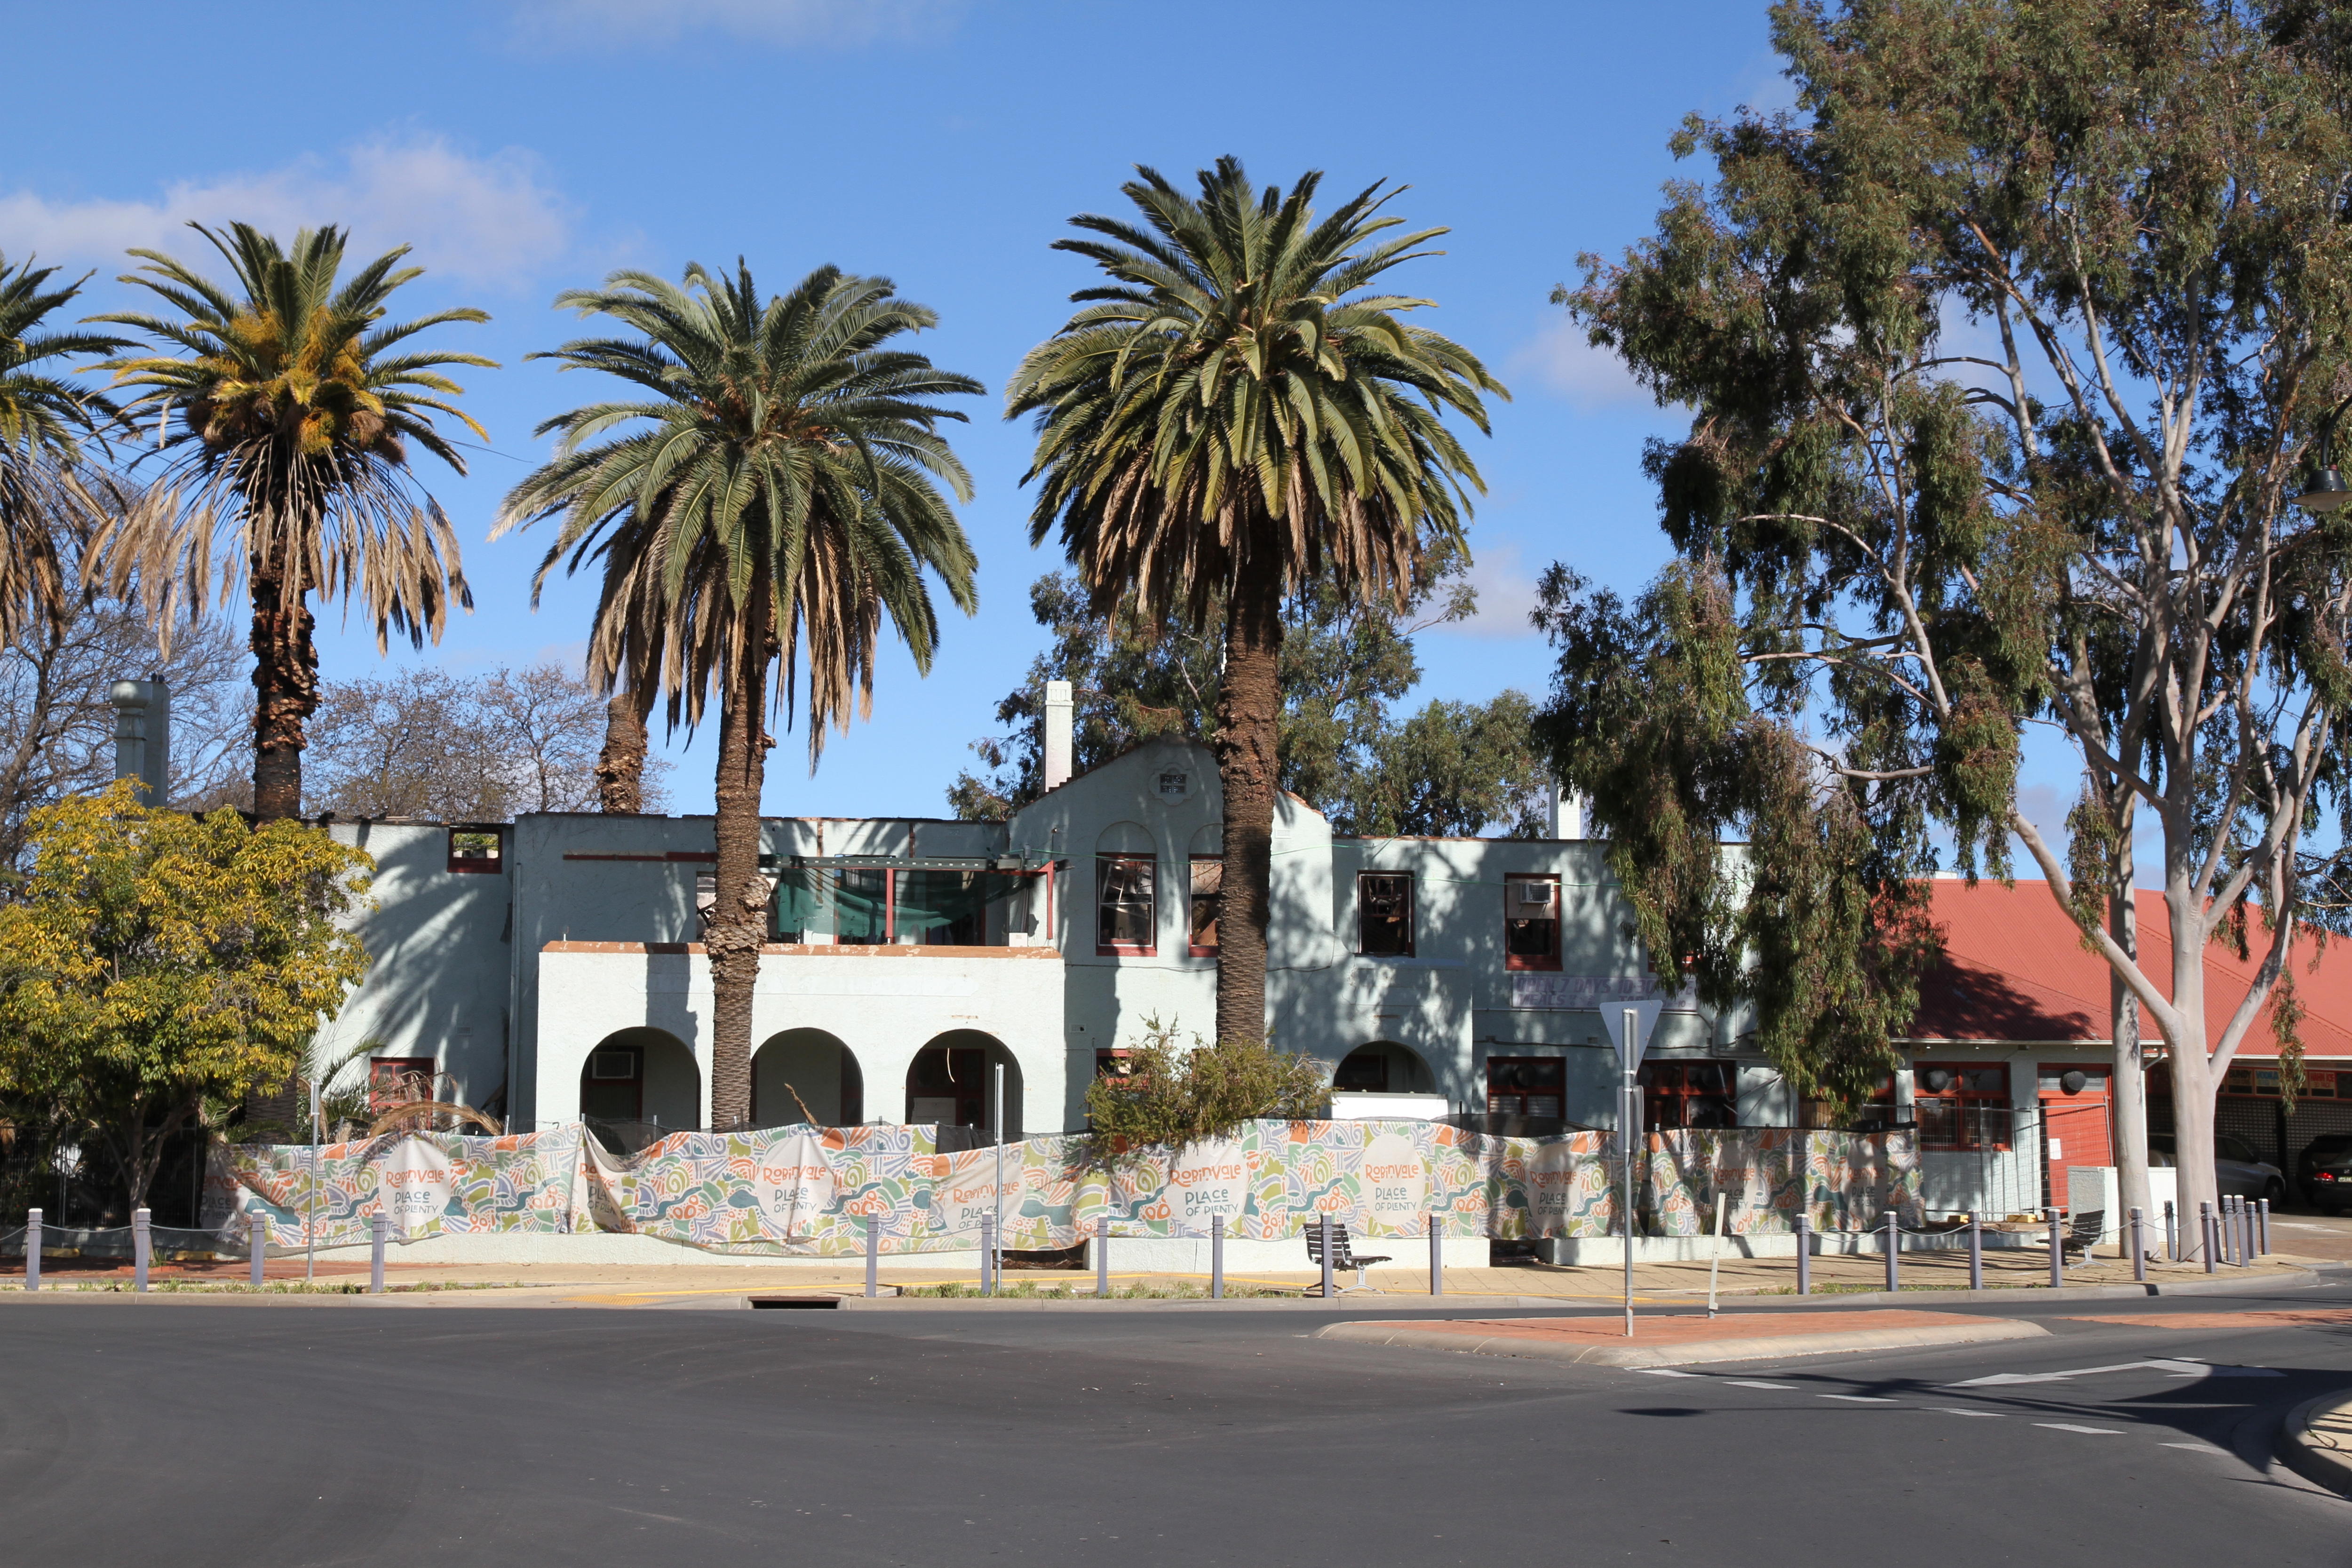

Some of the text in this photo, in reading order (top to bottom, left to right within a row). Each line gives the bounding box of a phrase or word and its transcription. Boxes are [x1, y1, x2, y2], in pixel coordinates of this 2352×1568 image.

[1560, 978, 1570, 993] 7
[1573, 978, 1611, 994] DAYS
[1518, 993, 1566, 1005] MEALS
[394, 1205, 438, 1215] OF PLENTY
[774, 1203, 787, 1213] OF
[1185, 1204, 1239, 1217] OF PLENTY
[1375, 1202, 1417, 1211] OF PLENTY
[959, 1220, 970, 1229] OF
